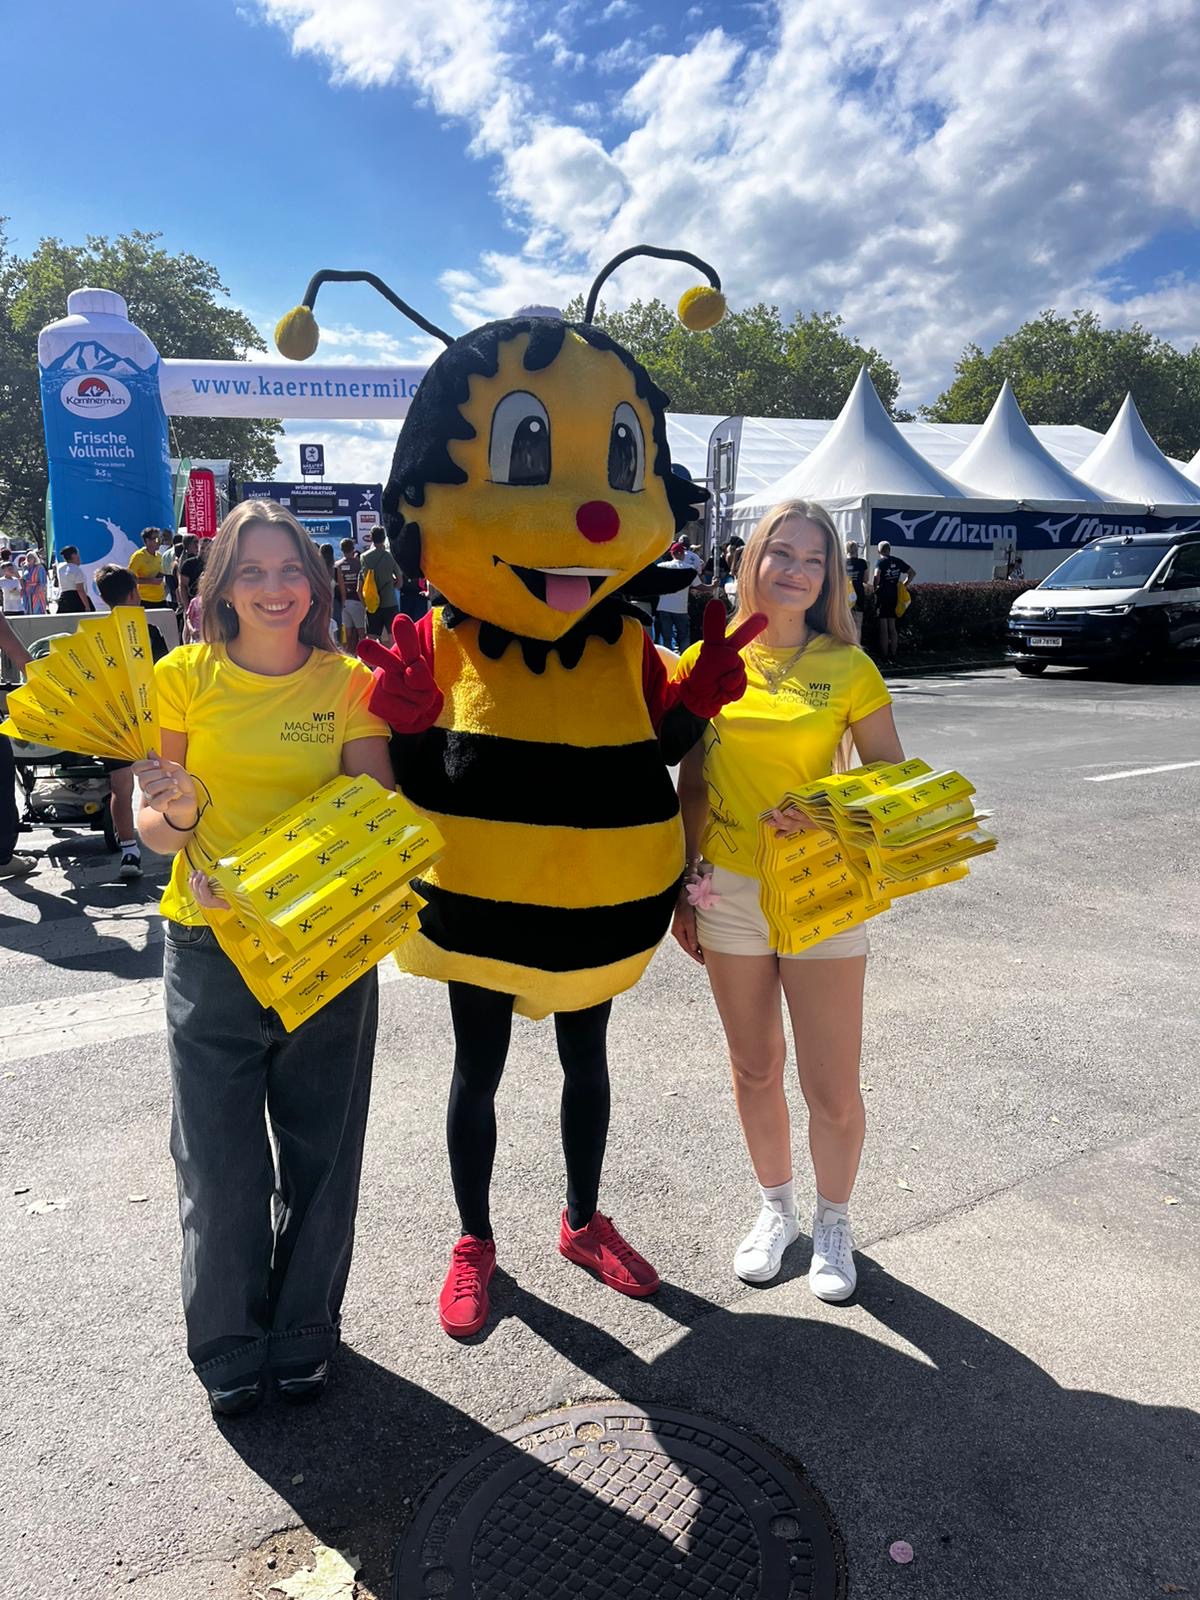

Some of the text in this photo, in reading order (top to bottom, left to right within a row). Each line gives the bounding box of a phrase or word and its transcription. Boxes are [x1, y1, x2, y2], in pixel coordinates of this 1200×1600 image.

[192, 376, 423, 398] www.kaerntnermilc
[74, 431, 127, 444] Frische
[69, 445, 135, 458] Vollmilch
[188, 495, 196, 532] WIENER
[809, 682, 831, 691] WIR
[312, 711, 335, 721] WIR
[284, 721, 335, 732] MACHT'S
